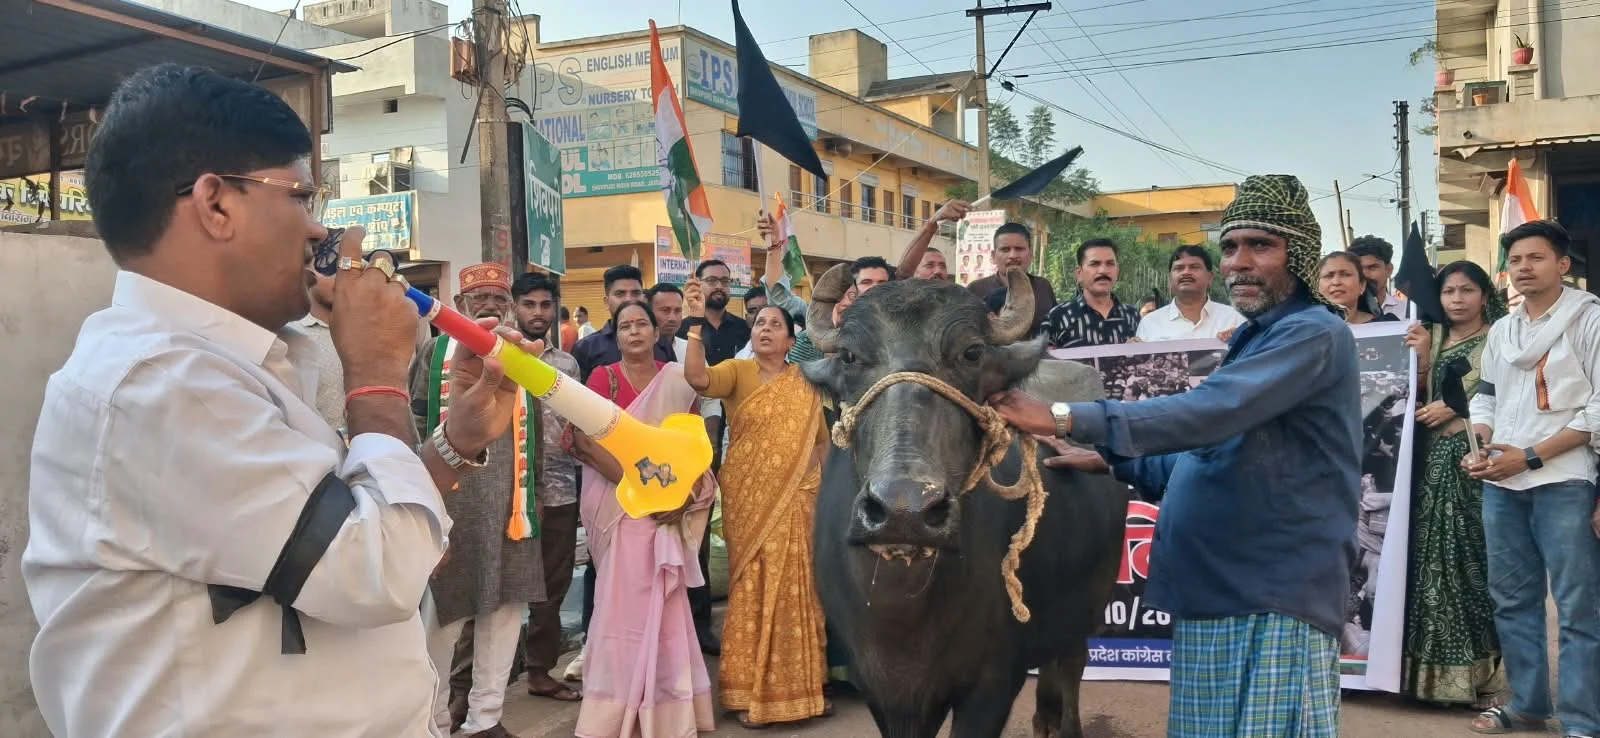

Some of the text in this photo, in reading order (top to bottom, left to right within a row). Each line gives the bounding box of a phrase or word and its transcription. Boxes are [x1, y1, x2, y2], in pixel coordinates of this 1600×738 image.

[587, 46, 679, 73] ENGLISH MEUM
[531, 57, 583, 110] PS
[588, 89, 636, 106] NURSERY
[529, 160, 561, 237] शिवपुरी
[1088, 645, 1119, 662] प्रदेश
[1121, 645, 1163, 663] कांग्रेस
